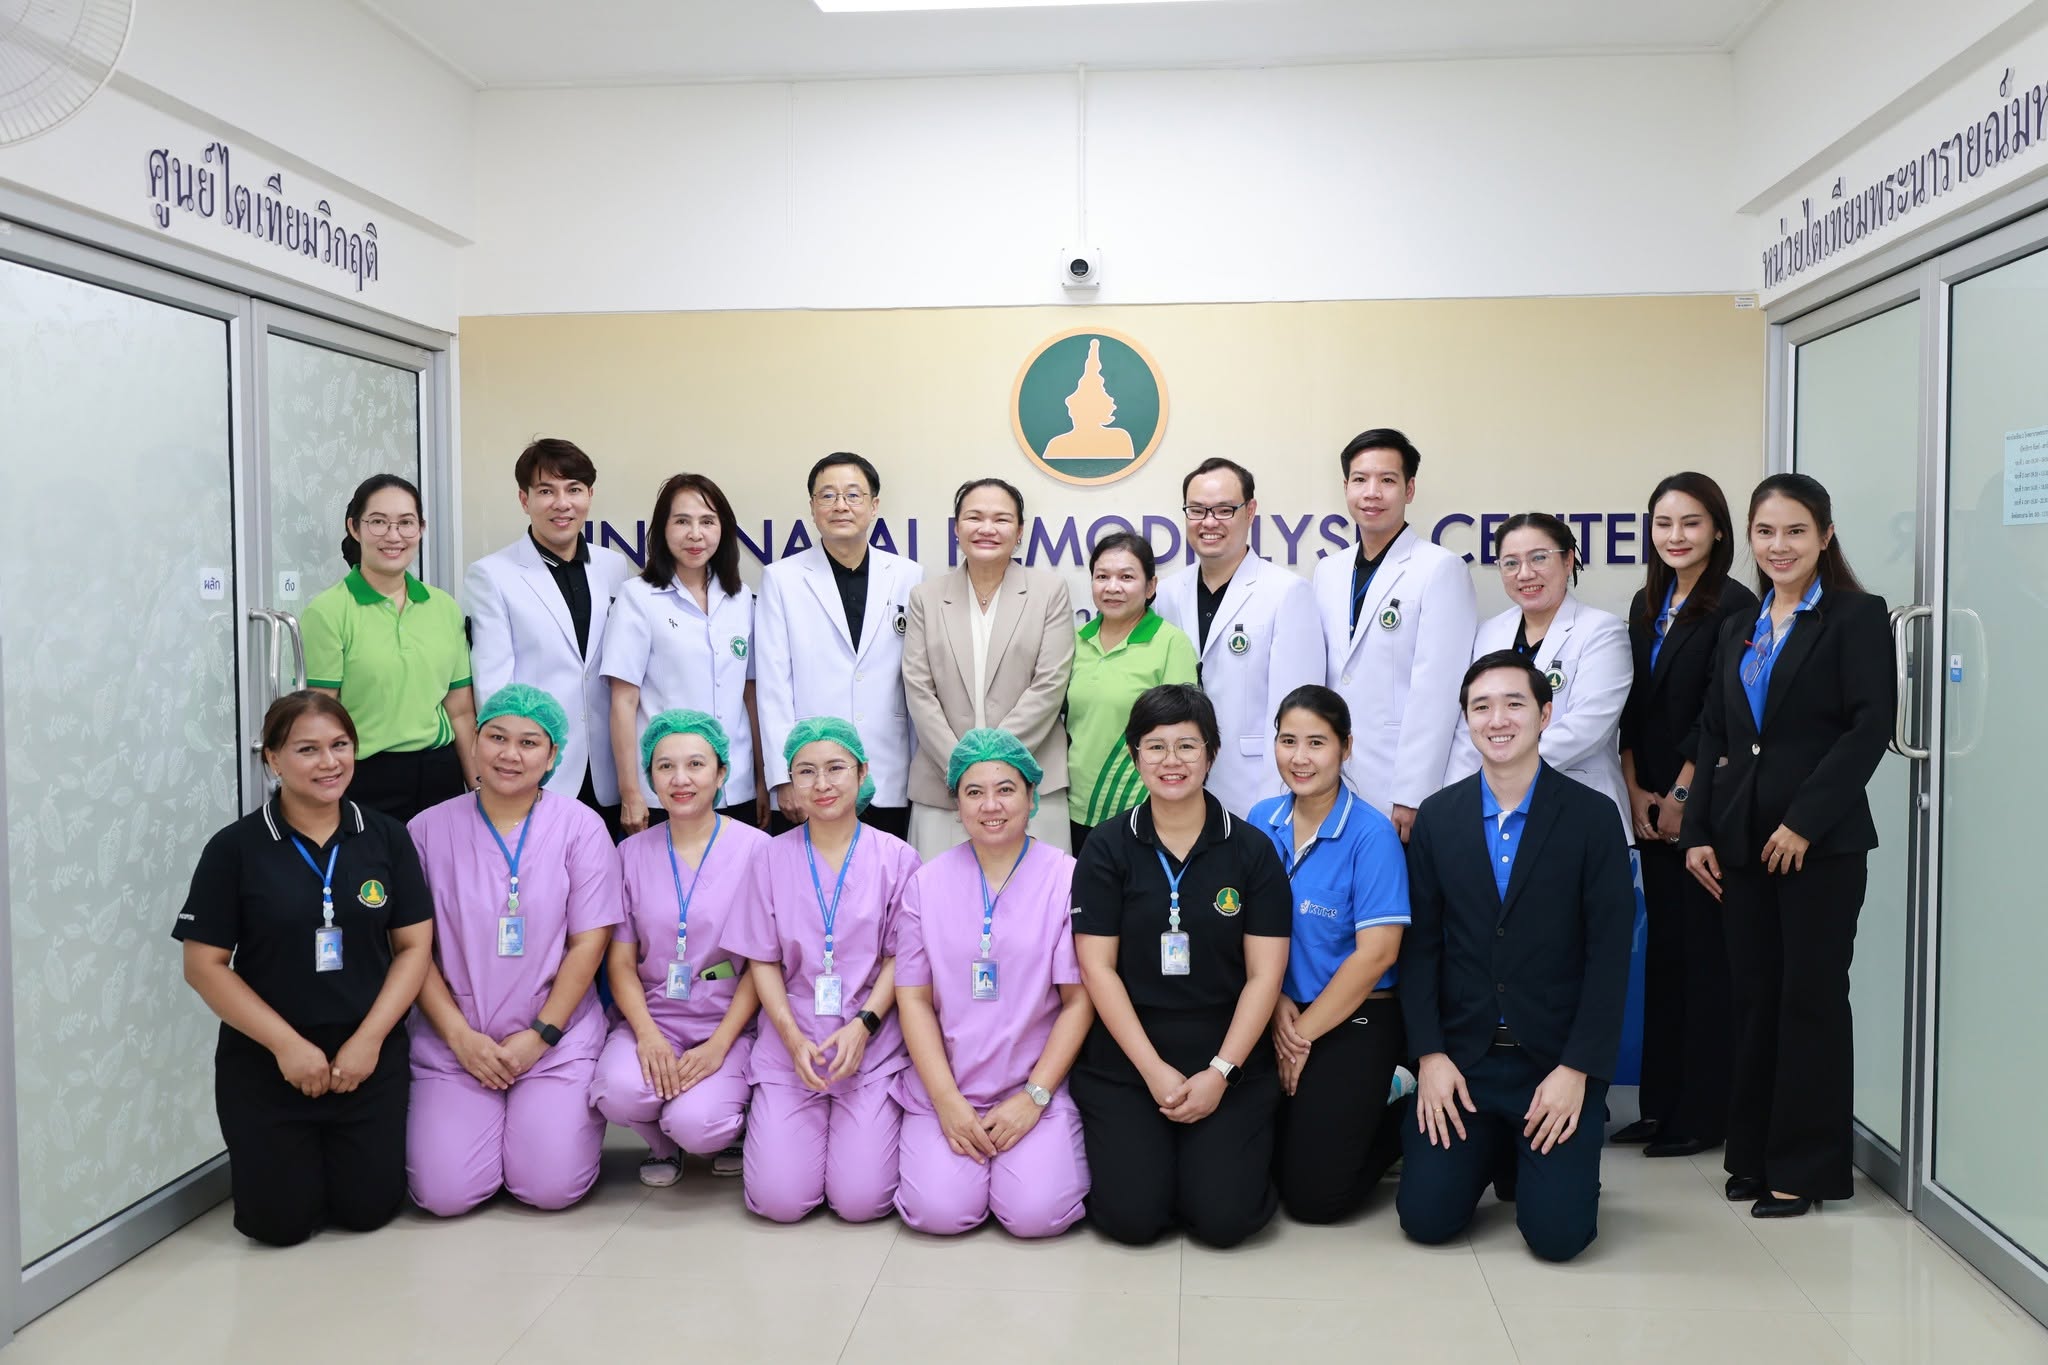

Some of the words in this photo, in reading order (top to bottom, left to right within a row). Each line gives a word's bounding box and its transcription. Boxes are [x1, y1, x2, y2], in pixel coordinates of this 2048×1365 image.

[149, 142, 378, 292] ศูนย์ไตเทียมวิกฤติ
[735, 517, 918, 566] NAAI
[1431, 512, 1651, 565] CETE
[204, 576, 221, 591] ผลัก
